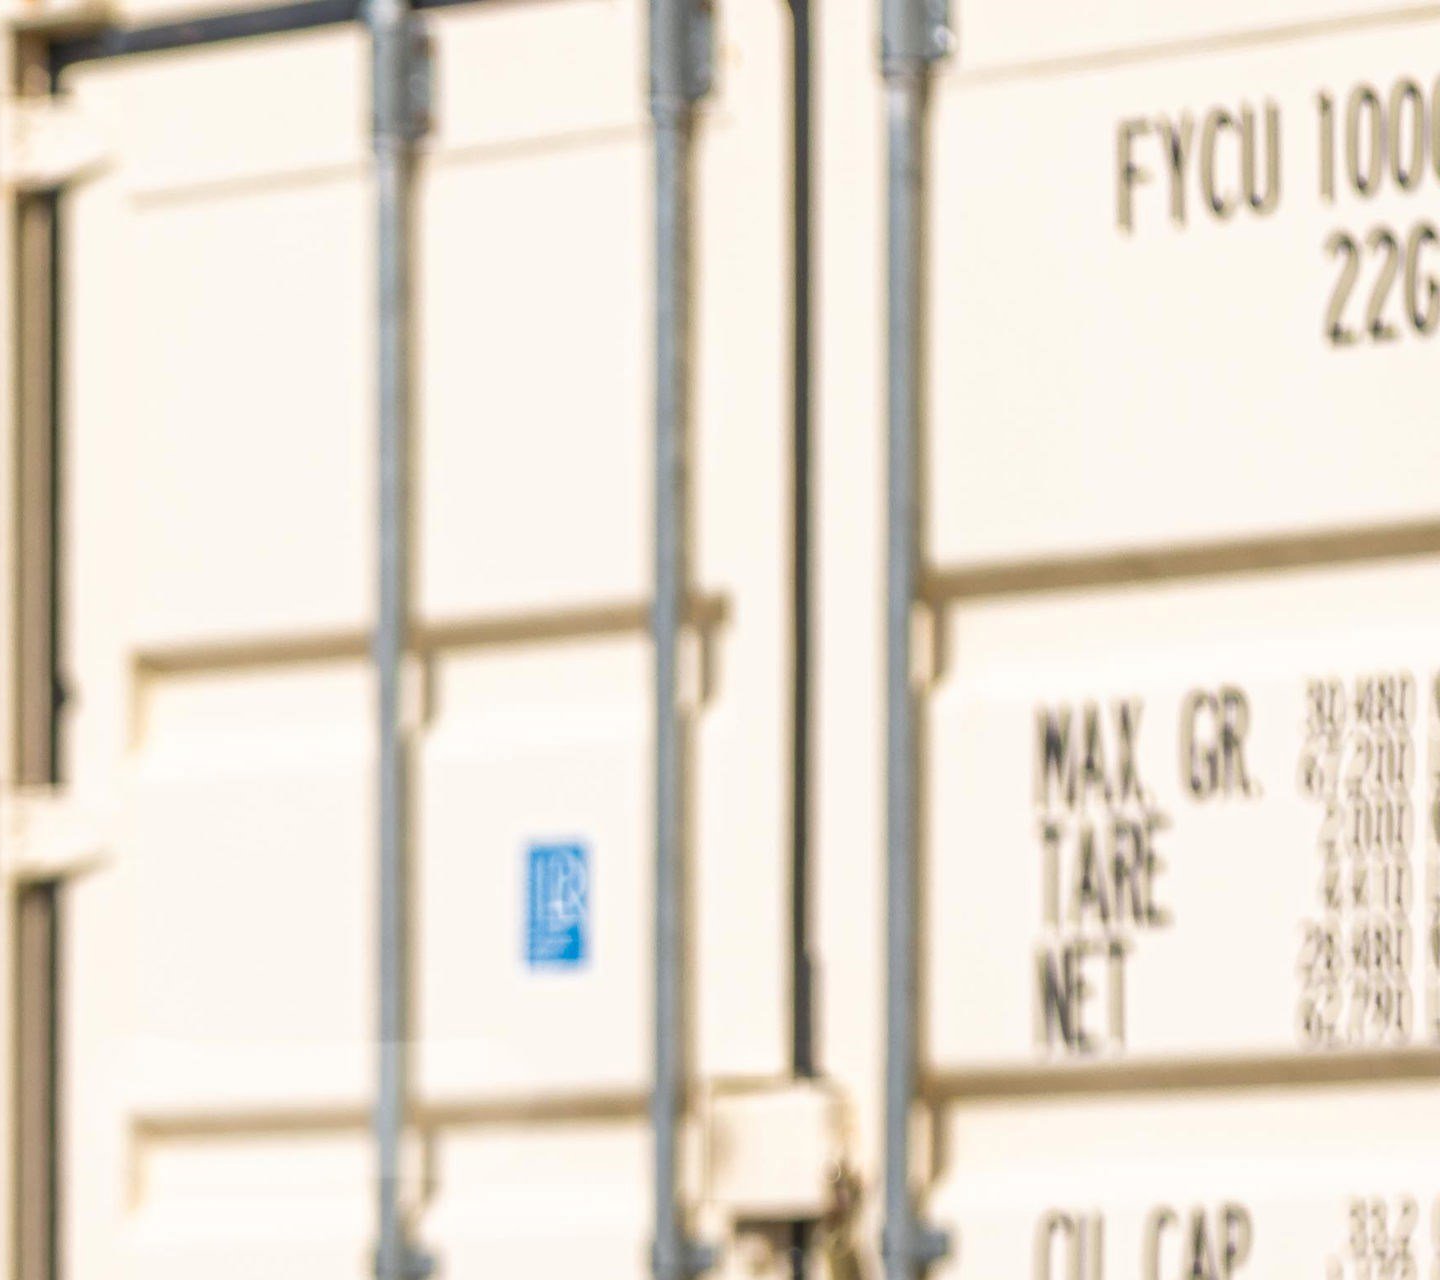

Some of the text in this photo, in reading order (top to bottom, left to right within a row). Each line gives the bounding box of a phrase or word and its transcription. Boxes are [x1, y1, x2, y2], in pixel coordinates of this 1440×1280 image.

[1113, 70, 1440, 239] FYCU 100
[1033, 697, 1146, 814] MAX
[1040, 808, 1172, 932] TARE
[1033, 935, 1132, 1060] NET
